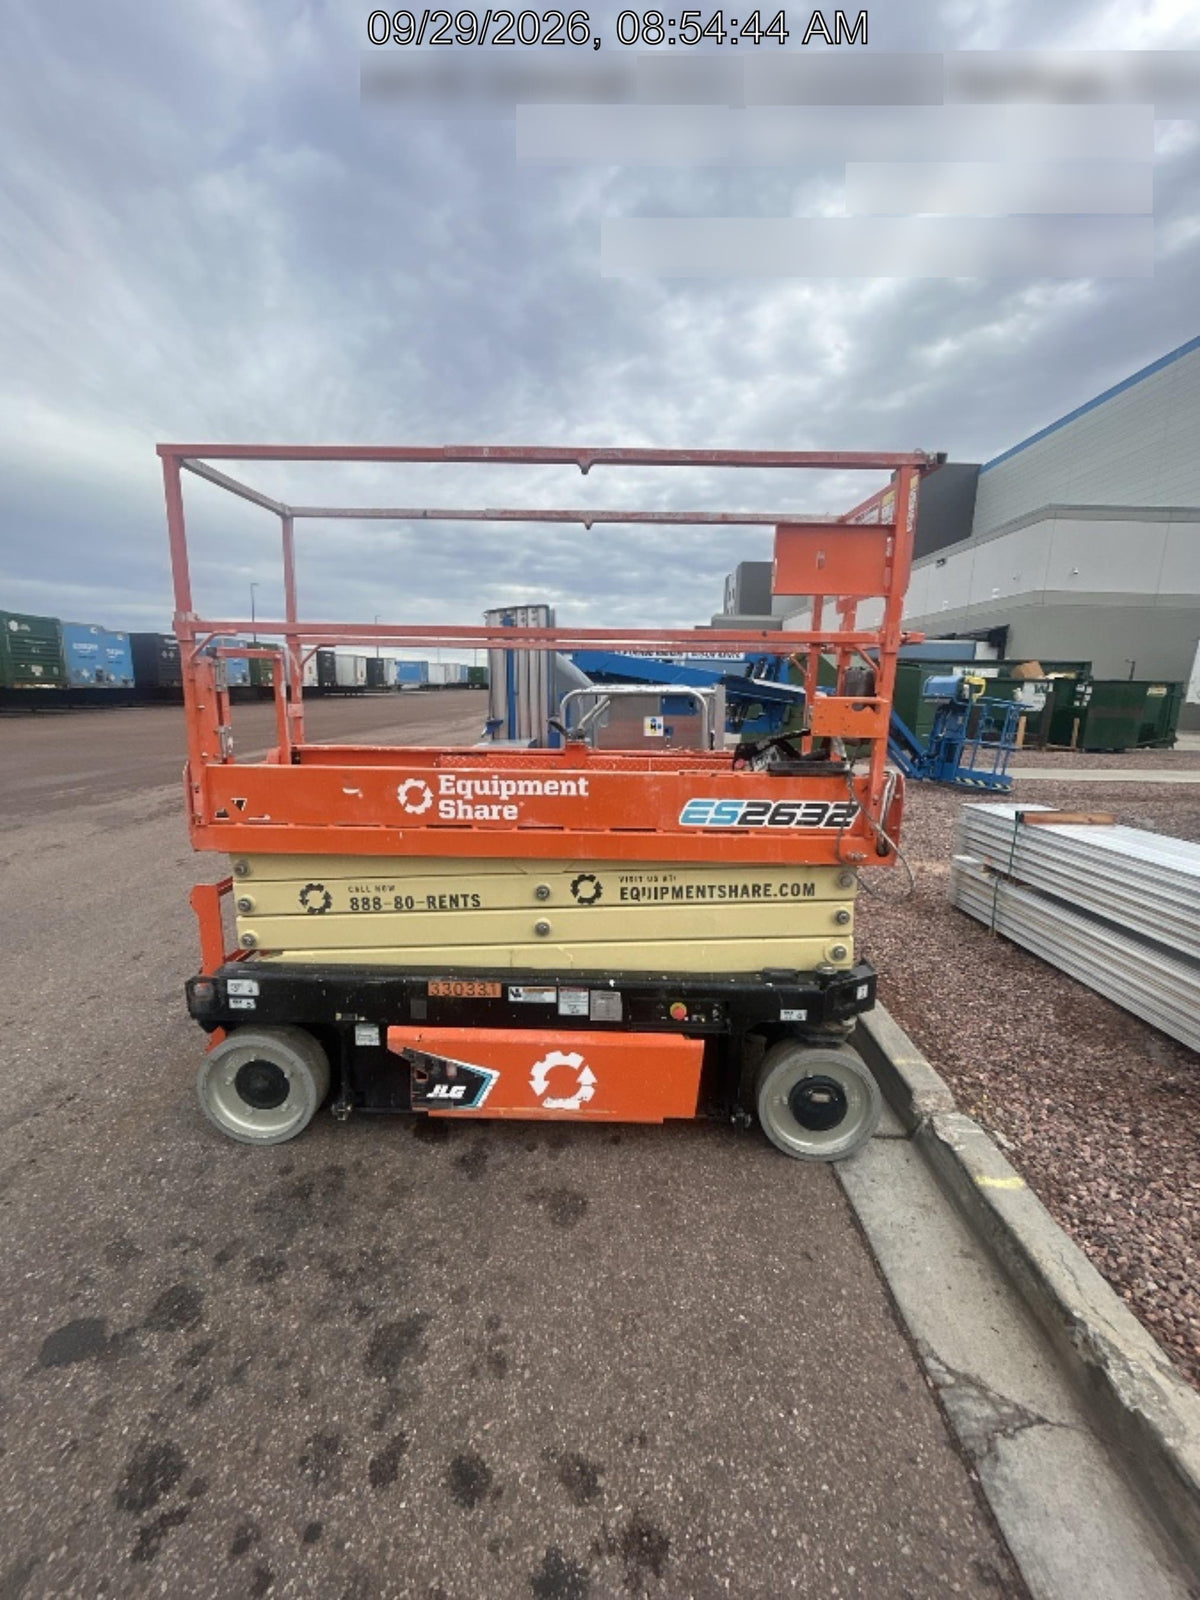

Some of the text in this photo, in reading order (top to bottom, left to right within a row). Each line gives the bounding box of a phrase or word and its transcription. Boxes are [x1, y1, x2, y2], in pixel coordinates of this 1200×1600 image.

[438, 774, 589, 800] Equipment
[438, 799, 519, 820] Share
[680, 800, 860, 827] ES2632
[620, 883, 815, 901] EQUIPMENTSHARE.COM
[350, 894, 481, 911] 888-80-RENTS
[426, 1084, 466, 1099] JLG
